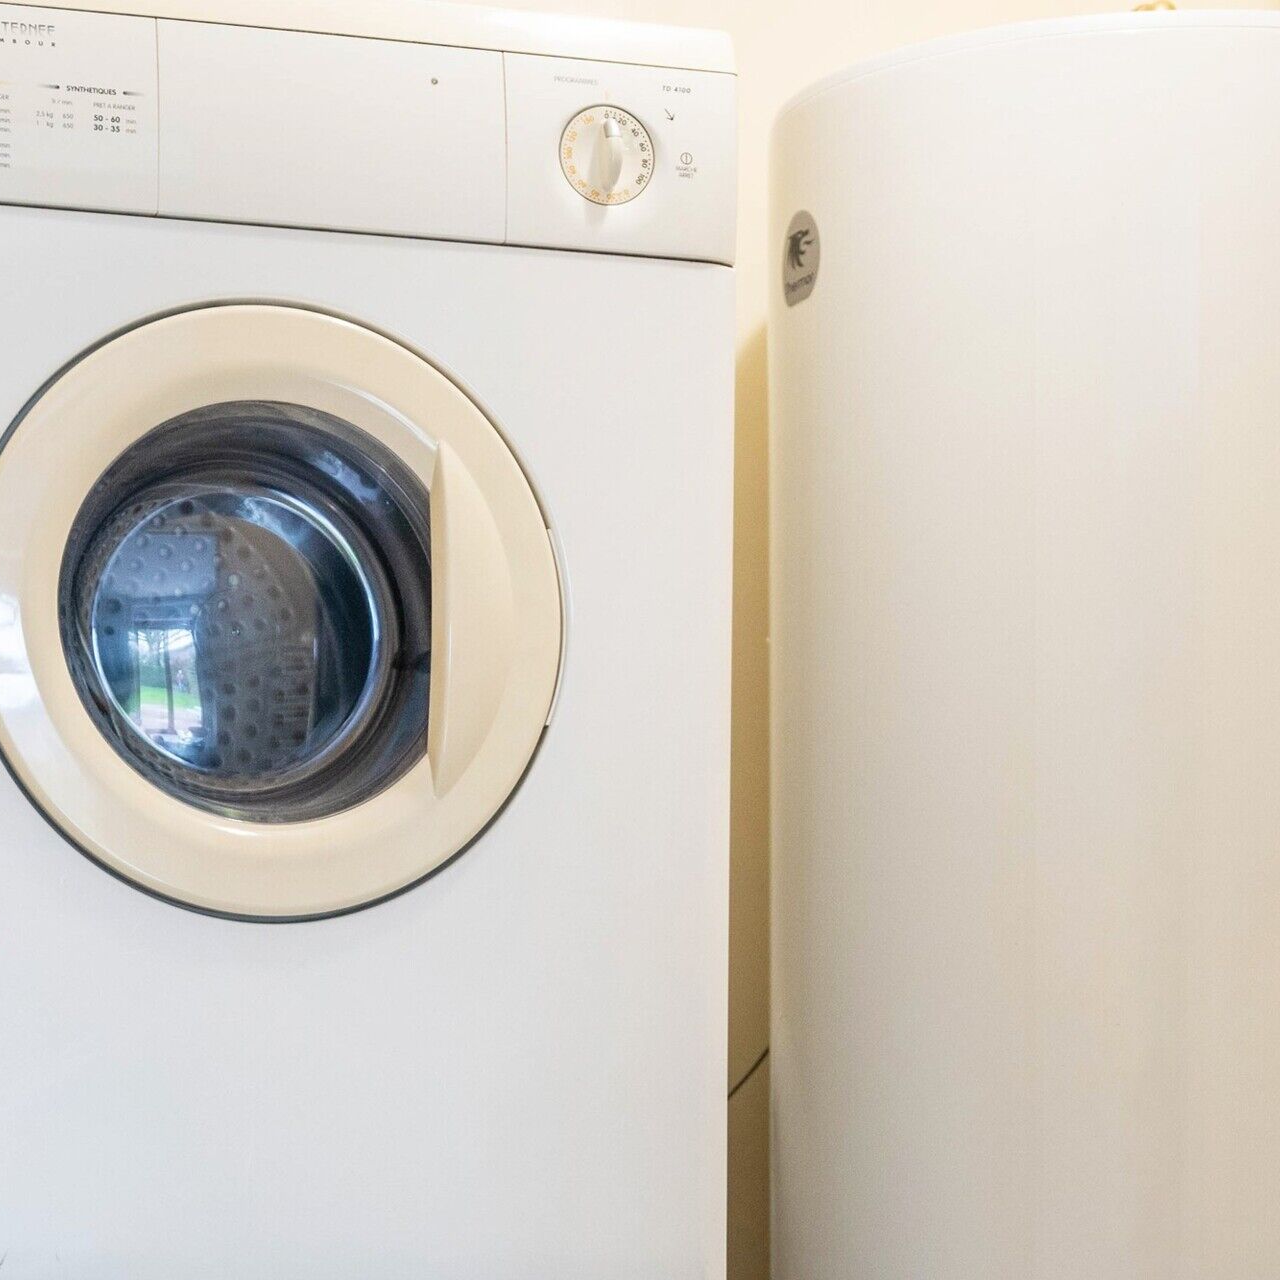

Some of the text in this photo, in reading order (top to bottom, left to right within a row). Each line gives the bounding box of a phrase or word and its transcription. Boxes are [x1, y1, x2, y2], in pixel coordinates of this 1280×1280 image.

[66, 85, 117, 95] SYNTHETIQUES
[93, 114, 103, 122] 50
[618, 117, 627, 126] 20
[631, 127, 639, 137] 40
[639, 142, 647, 152] 60
[641, 158, 648, 168] 80
[635, 174, 645, 185] 100
